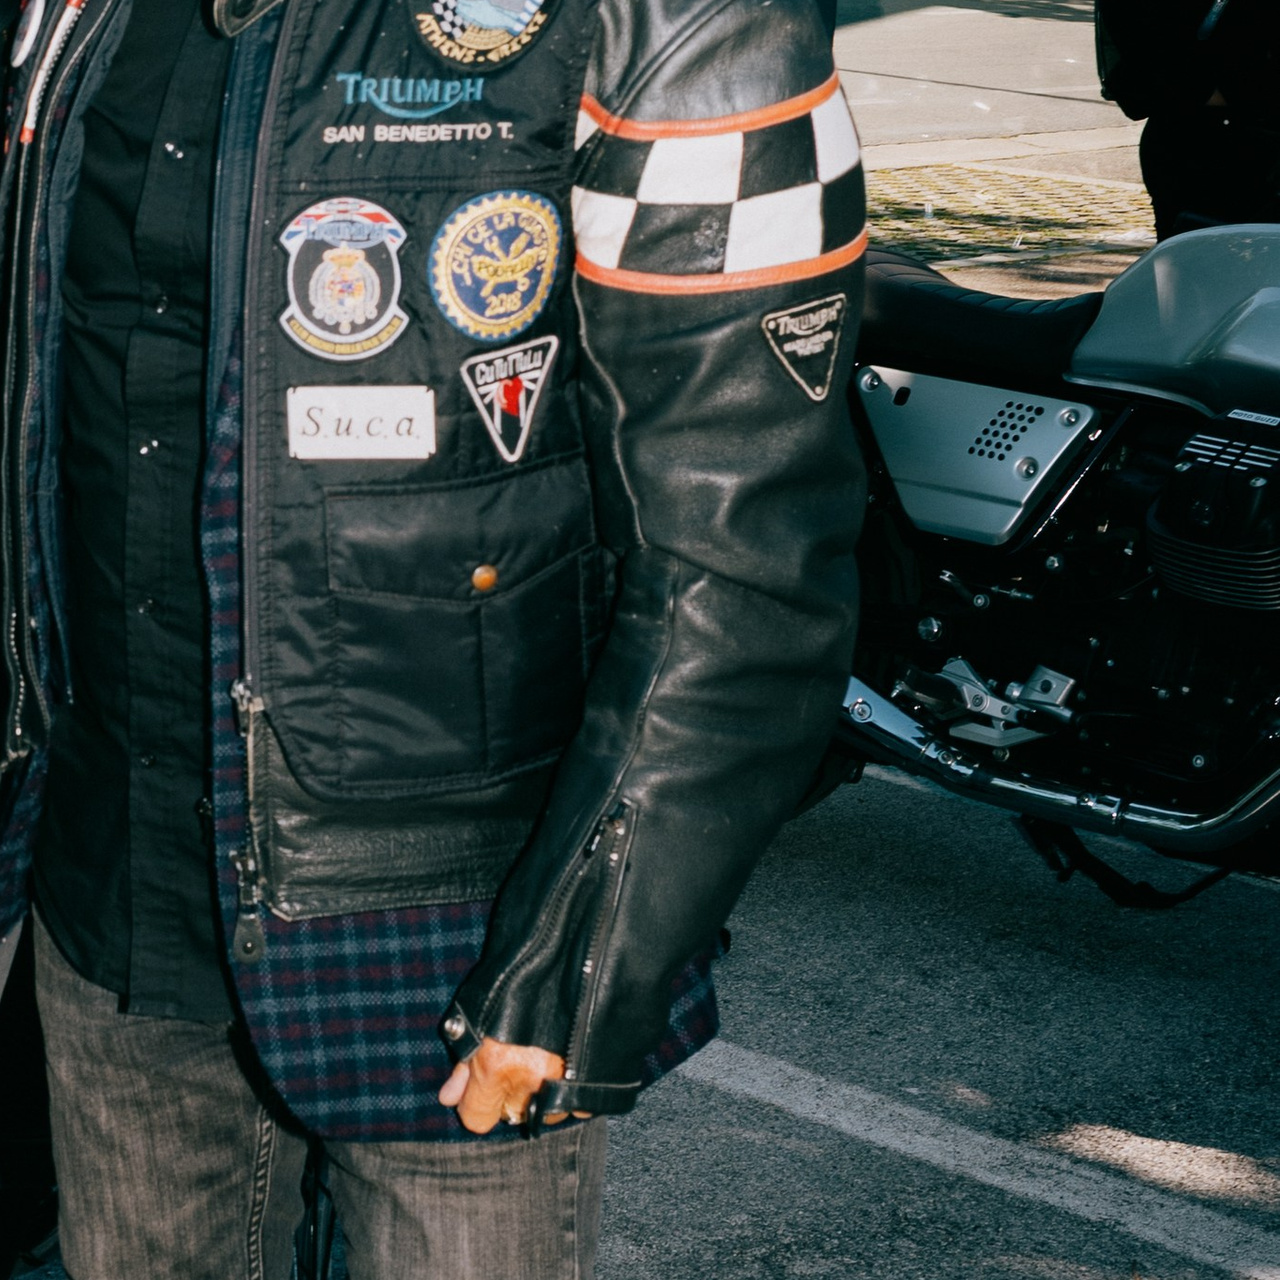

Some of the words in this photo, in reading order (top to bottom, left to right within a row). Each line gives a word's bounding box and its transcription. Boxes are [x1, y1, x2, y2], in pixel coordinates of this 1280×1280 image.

[416, 13, 477, 64] ATHENS
[336, 72, 484, 119] TRIUMPH
[323, 125, 365, 144] SAN
[374, 122, 492, 143] BENEDETTO
[497, 122, 515, 140] T.
